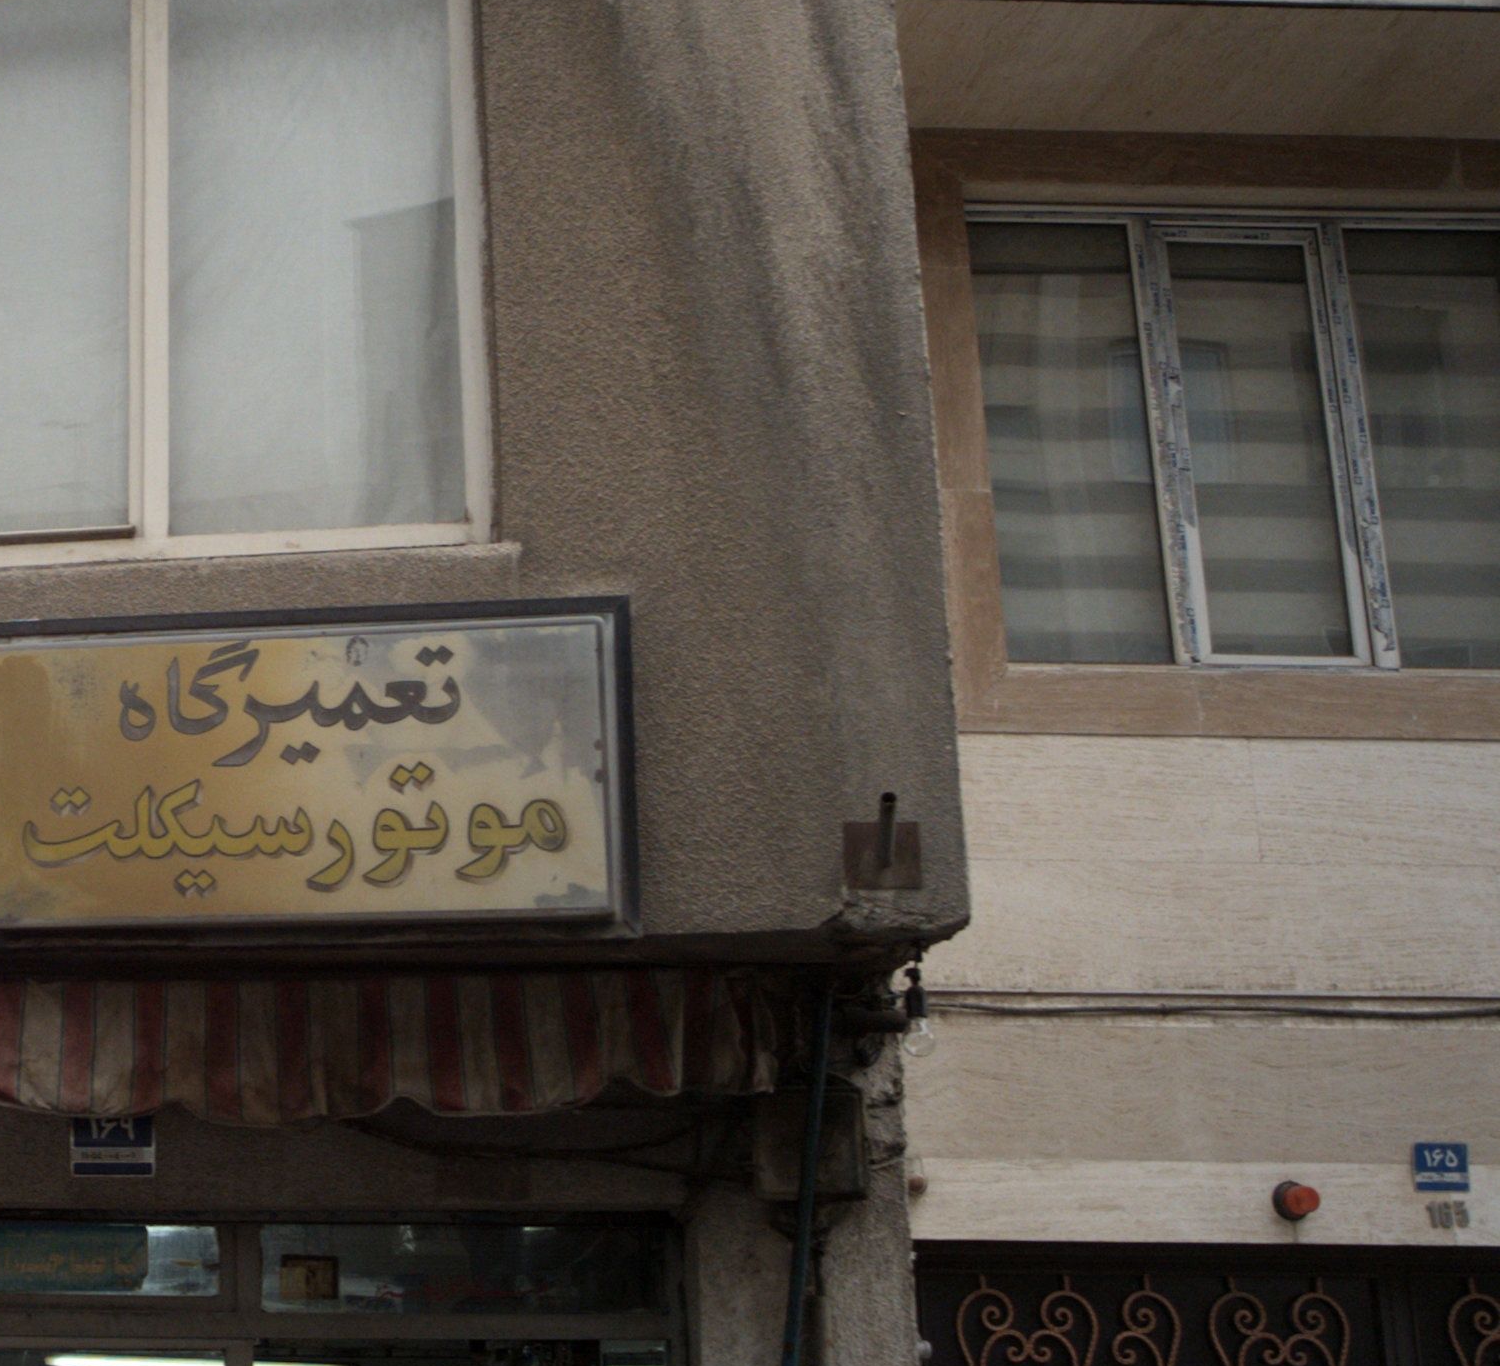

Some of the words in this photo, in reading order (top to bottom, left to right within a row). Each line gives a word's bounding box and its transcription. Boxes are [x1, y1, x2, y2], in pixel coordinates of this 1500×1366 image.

[118, 640, 461, 767] تعمیرگاه
[22, 761, 570, 898] موتورسیکلت
[1423, 1148, 1459, 1168] ۱۶۵
[1425, 1201, 1470, 1229] 165
